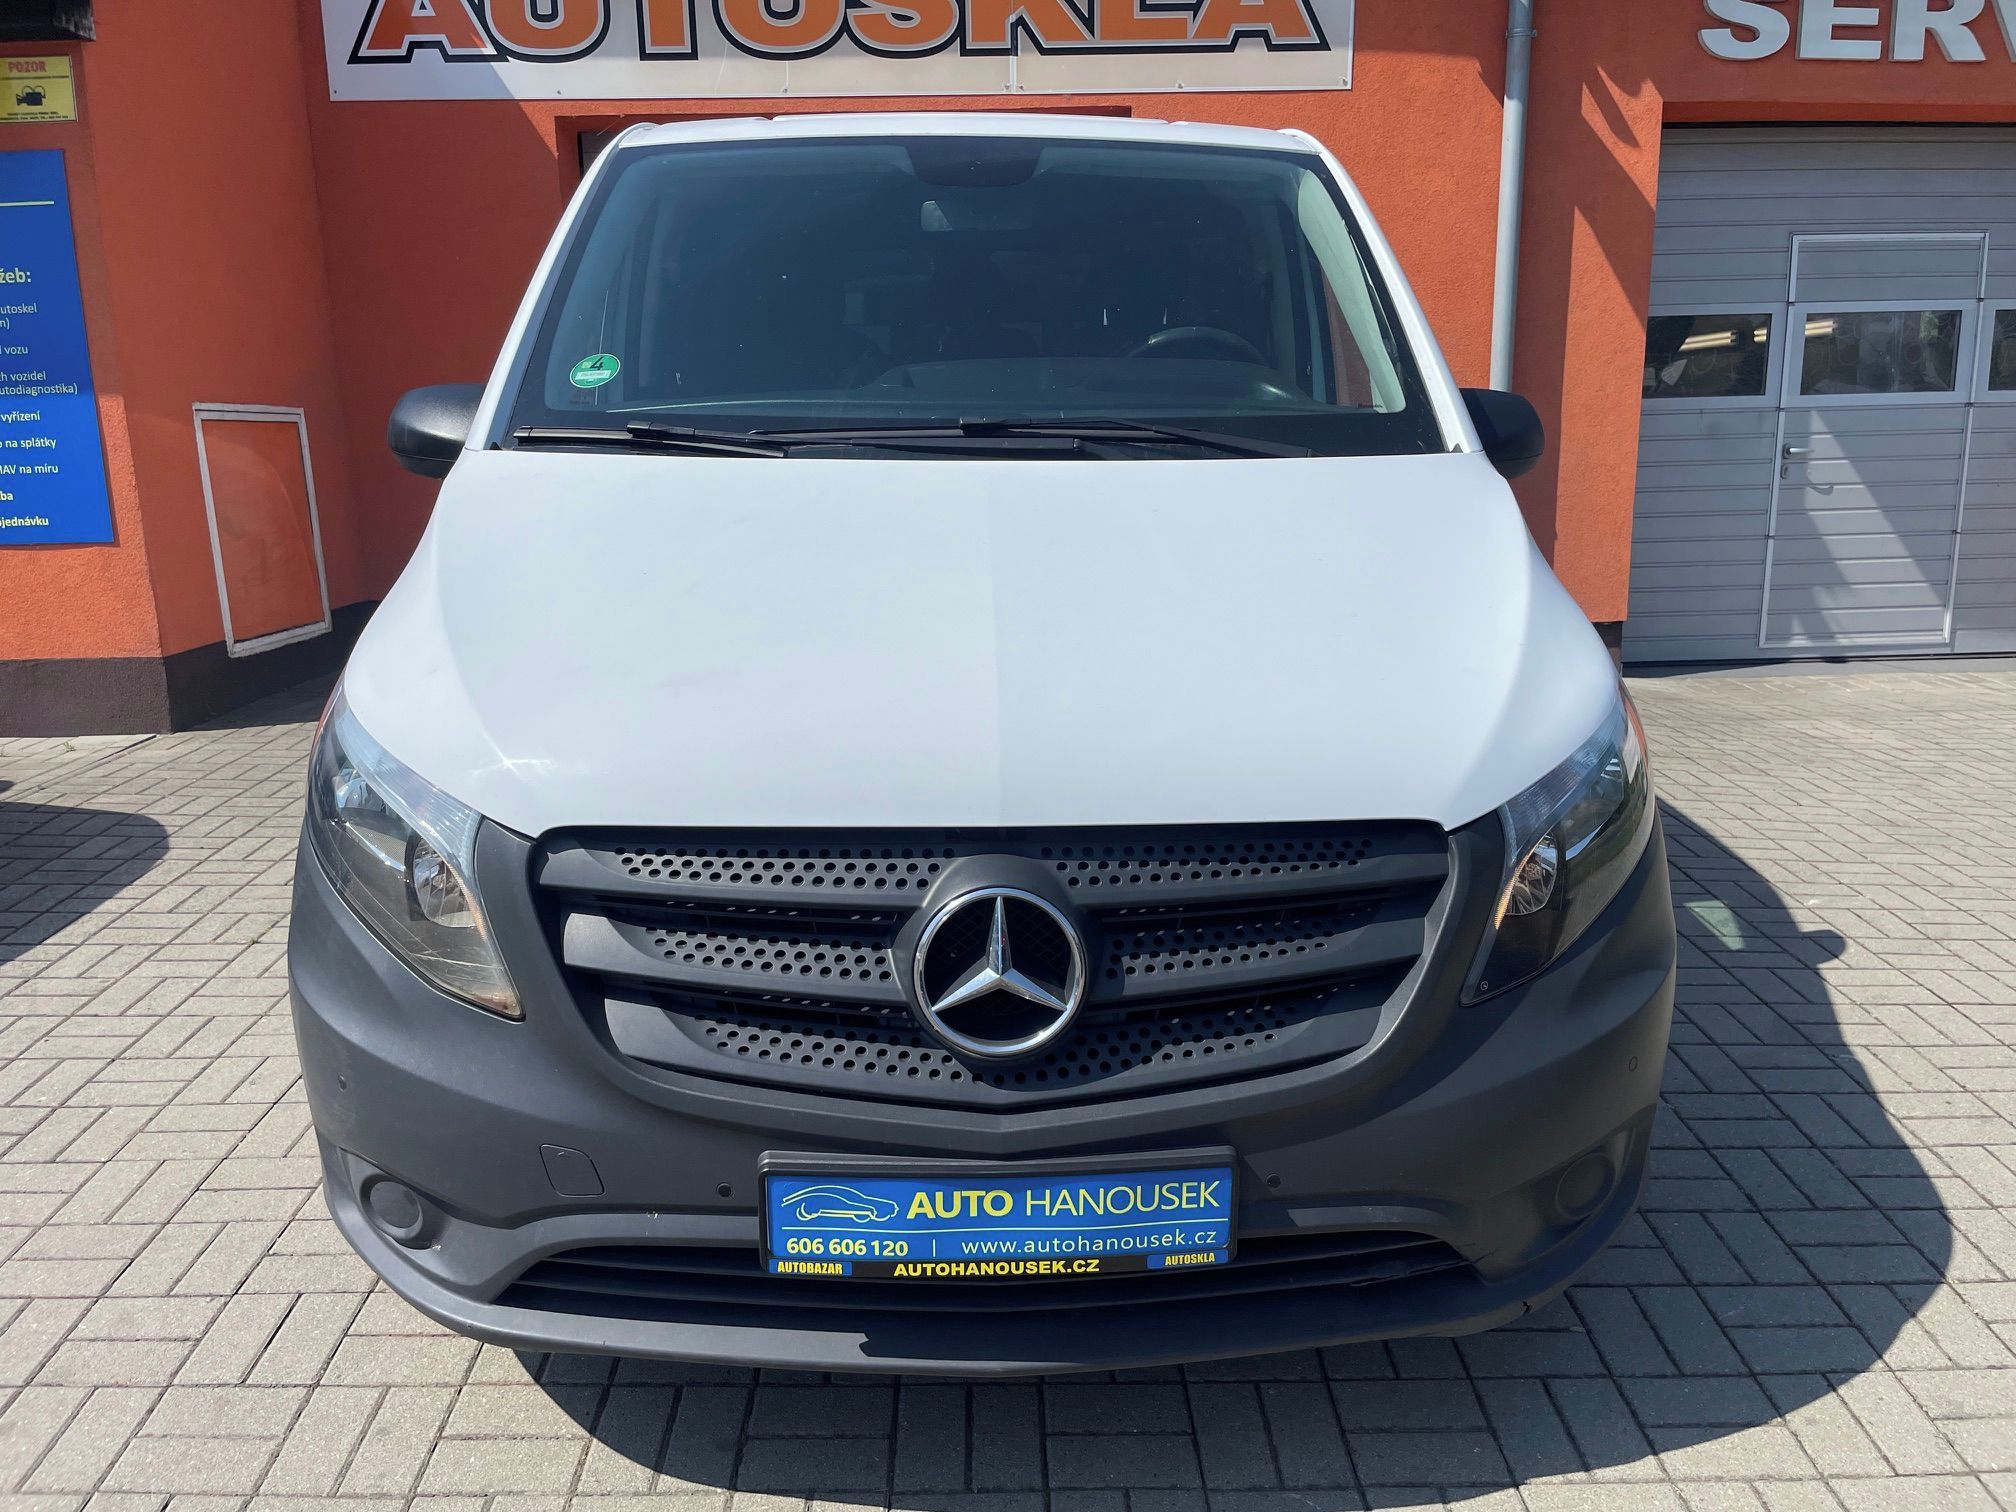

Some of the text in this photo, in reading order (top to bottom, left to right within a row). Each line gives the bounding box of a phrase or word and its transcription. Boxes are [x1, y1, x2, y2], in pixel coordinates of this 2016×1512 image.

[8, 61, 47, 73] POZOR
[4, 345, 28, 354] vozu
[590, 356, 605, 371] 4
[10, 371, 46, 381] vozidel
[1, 411, 40, 423] vyřízení
[6, 440, 18, 448] na
[20, 437, 57, 449] splátky
[20, 466, 32, 474] na
[35, 463, 59, 473] míru
[906, 1181, 1220, 1219] AUTO HANOUSEK
[786, 1229, 1217, 1257] 606 606 120 www.autohanousek.cz
[777, 1252, 1216, 1277] AUTOBAZAR AUTOHANOUSEK.CZ AUTOSKLA
